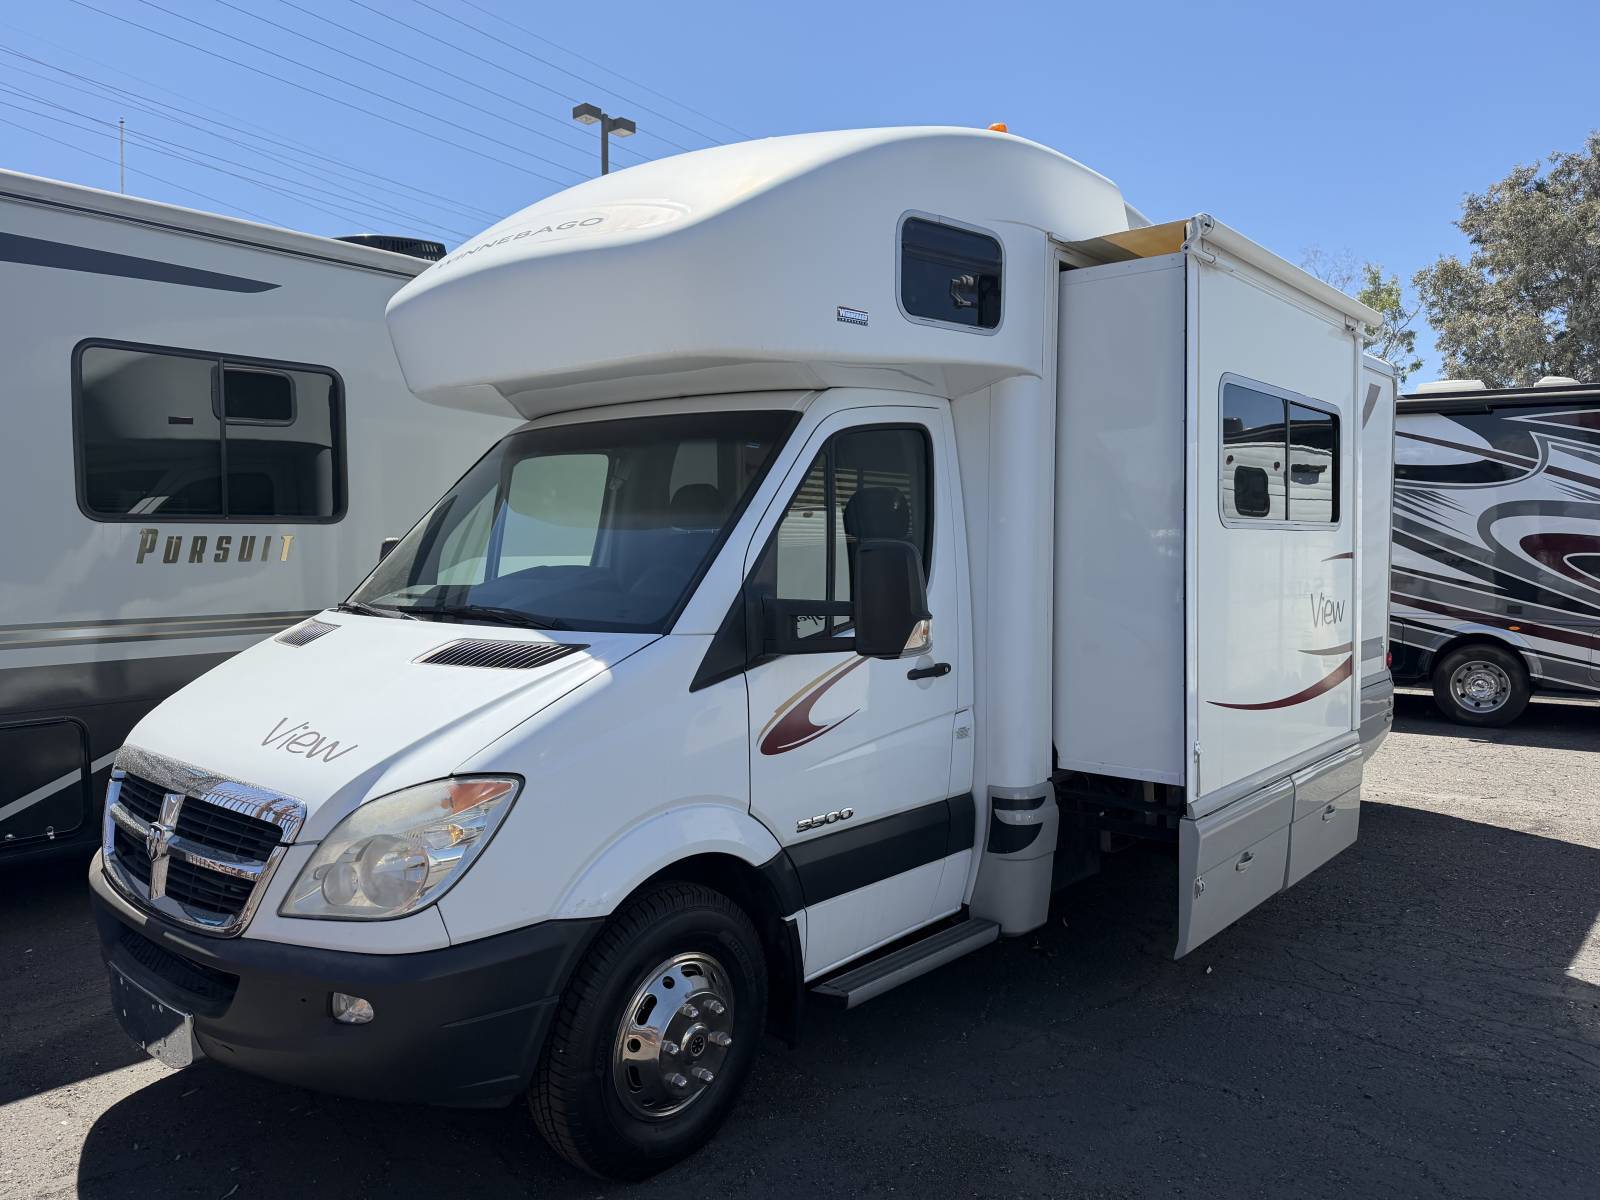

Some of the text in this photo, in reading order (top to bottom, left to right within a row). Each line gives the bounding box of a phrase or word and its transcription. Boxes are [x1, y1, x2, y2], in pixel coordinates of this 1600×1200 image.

[136, 528, 295, 564] PURSUIT
[1310, 592, 1346, 628] View
[261, 717, 359, 763] View
